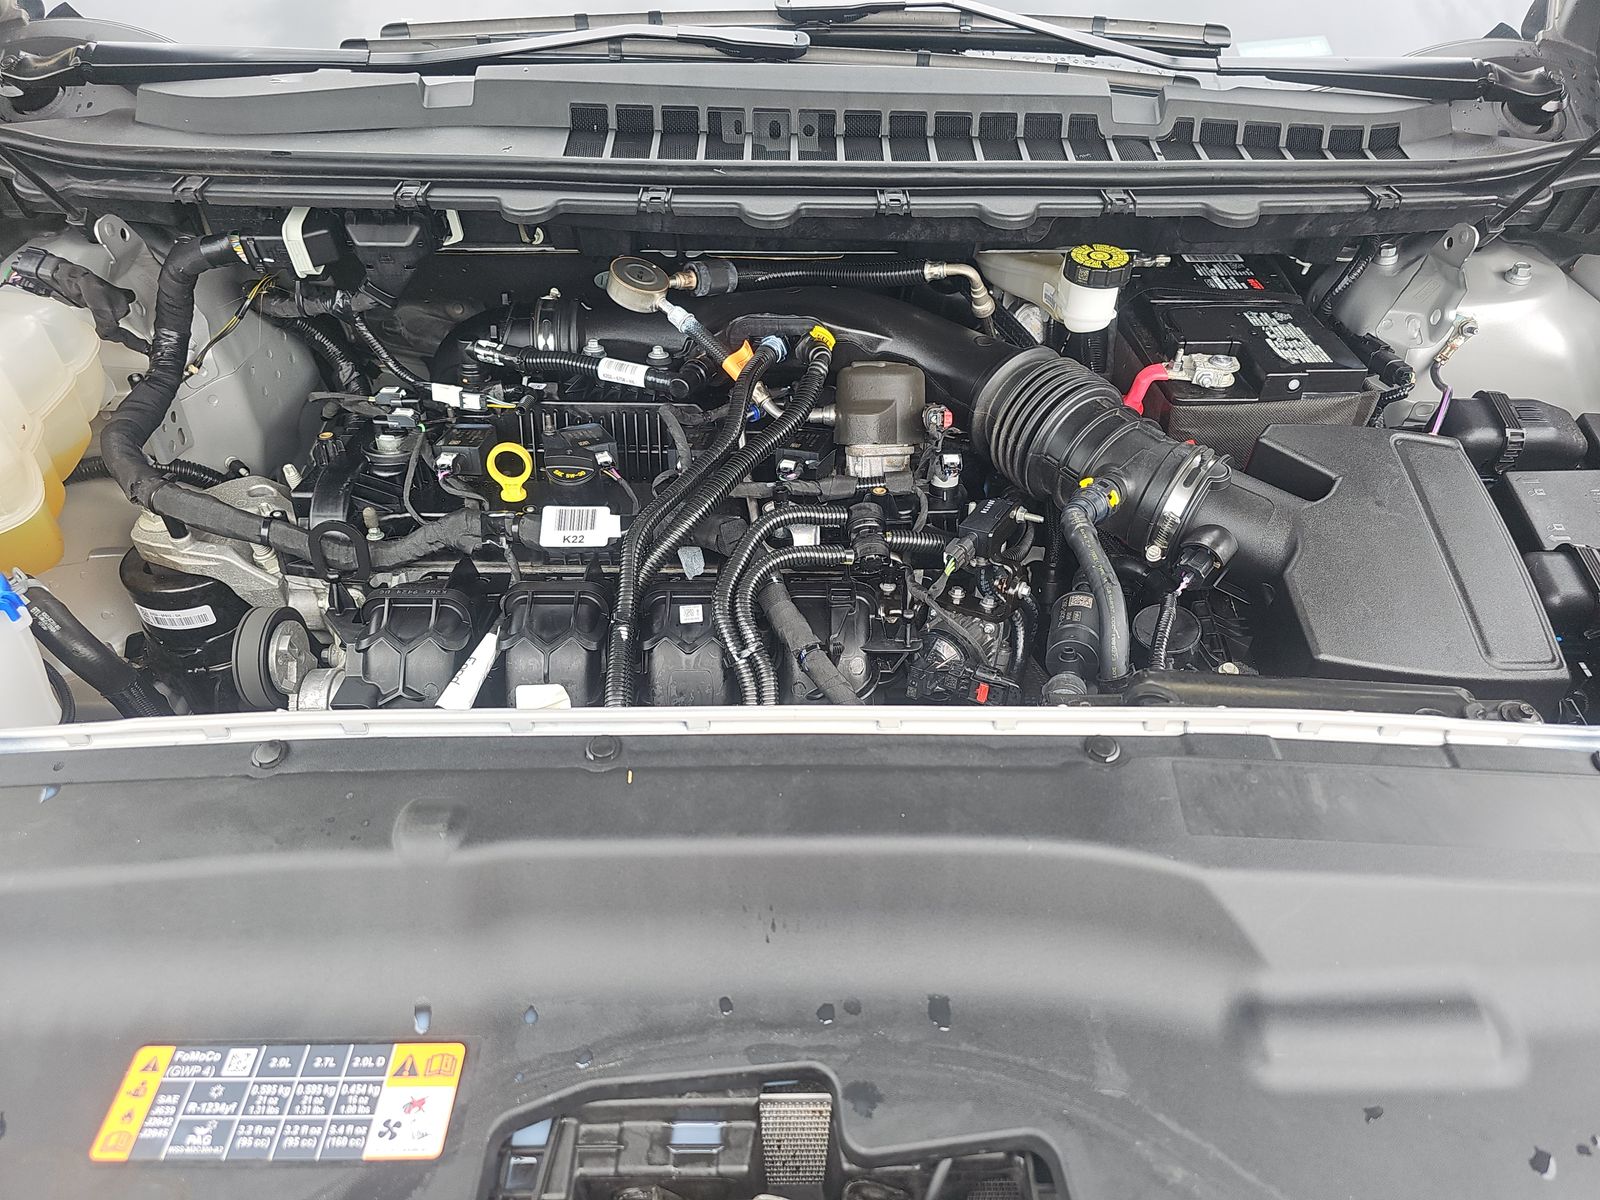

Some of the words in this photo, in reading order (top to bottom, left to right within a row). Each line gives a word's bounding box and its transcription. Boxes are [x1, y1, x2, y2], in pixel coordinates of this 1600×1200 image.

[562, 535, 585, 543] K22
[174, 1050, 222, 1062] FoMoCo
[268, 1057, 291, 1068] 2.0L
[313, 1057, 336, 1068] 2.7L
[352, 1057, 374, 1068] 2.0L
[376, 1057, 385, 1067] D
[166, 1065, 202, 1078] (GWP
[202, 1065, 216, 1078] 4)
[278, 1084, 292, 1098] kg
[324, 1084, 337, 1098] kg
[369, 1084, 381, 1098] kg
[157, 1094, 180, 1104] SAE
[187, 1102, 238, 1115] R-1234yf
[266, 1105, 280, 1114] lbs
[312, 1105, 326, 1114] lbs
[357, 1105, 370, 1114] lbs
[262, 1126, 277, 1135] oz
[309, 1126, 323, 1135] oz
[353, 1126, 368, 1135] oz
[185, 1135, 212, 1145] PAG
